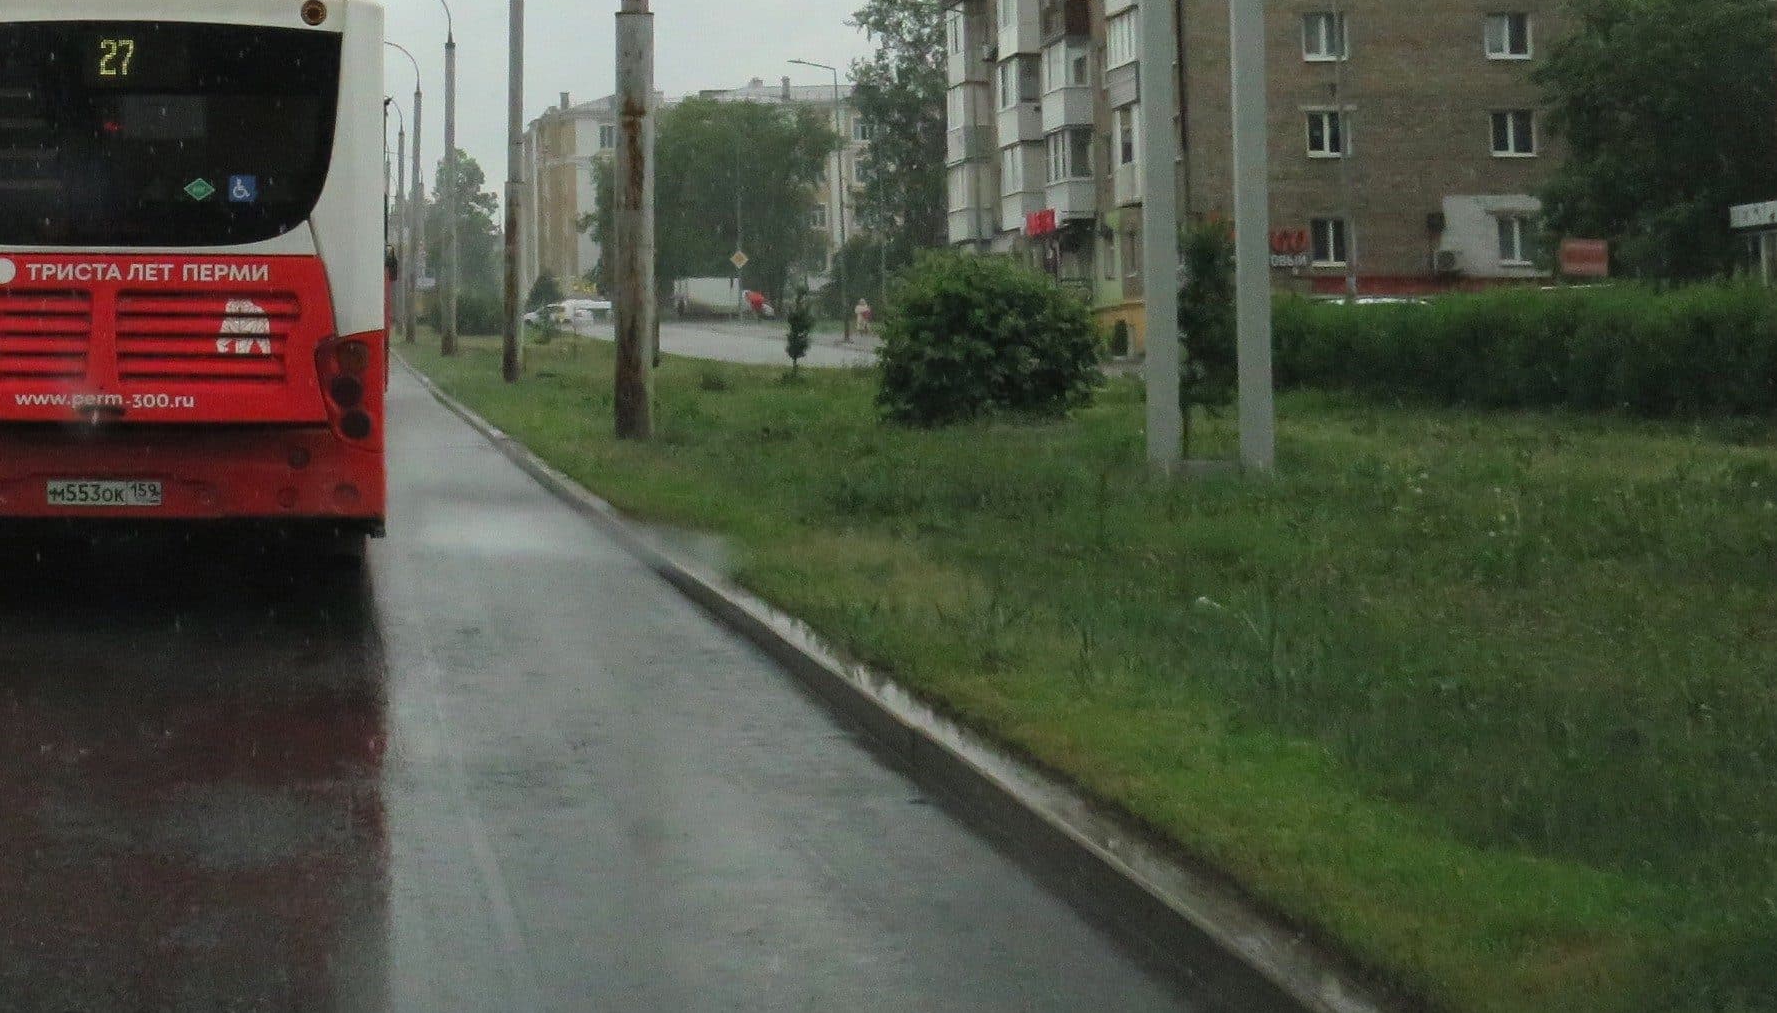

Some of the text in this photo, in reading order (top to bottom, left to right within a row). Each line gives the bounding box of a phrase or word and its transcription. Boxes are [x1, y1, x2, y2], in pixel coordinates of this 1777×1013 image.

[100, 39, 134, 75] 27
[26, 263, 122, 282] ТРИСТА
[127, 264, 174, 282] ЛЕТ
[182, 264, 269, 282] ПЕРМИ
[14, 393, 195, 409] www.perm-300.ru
